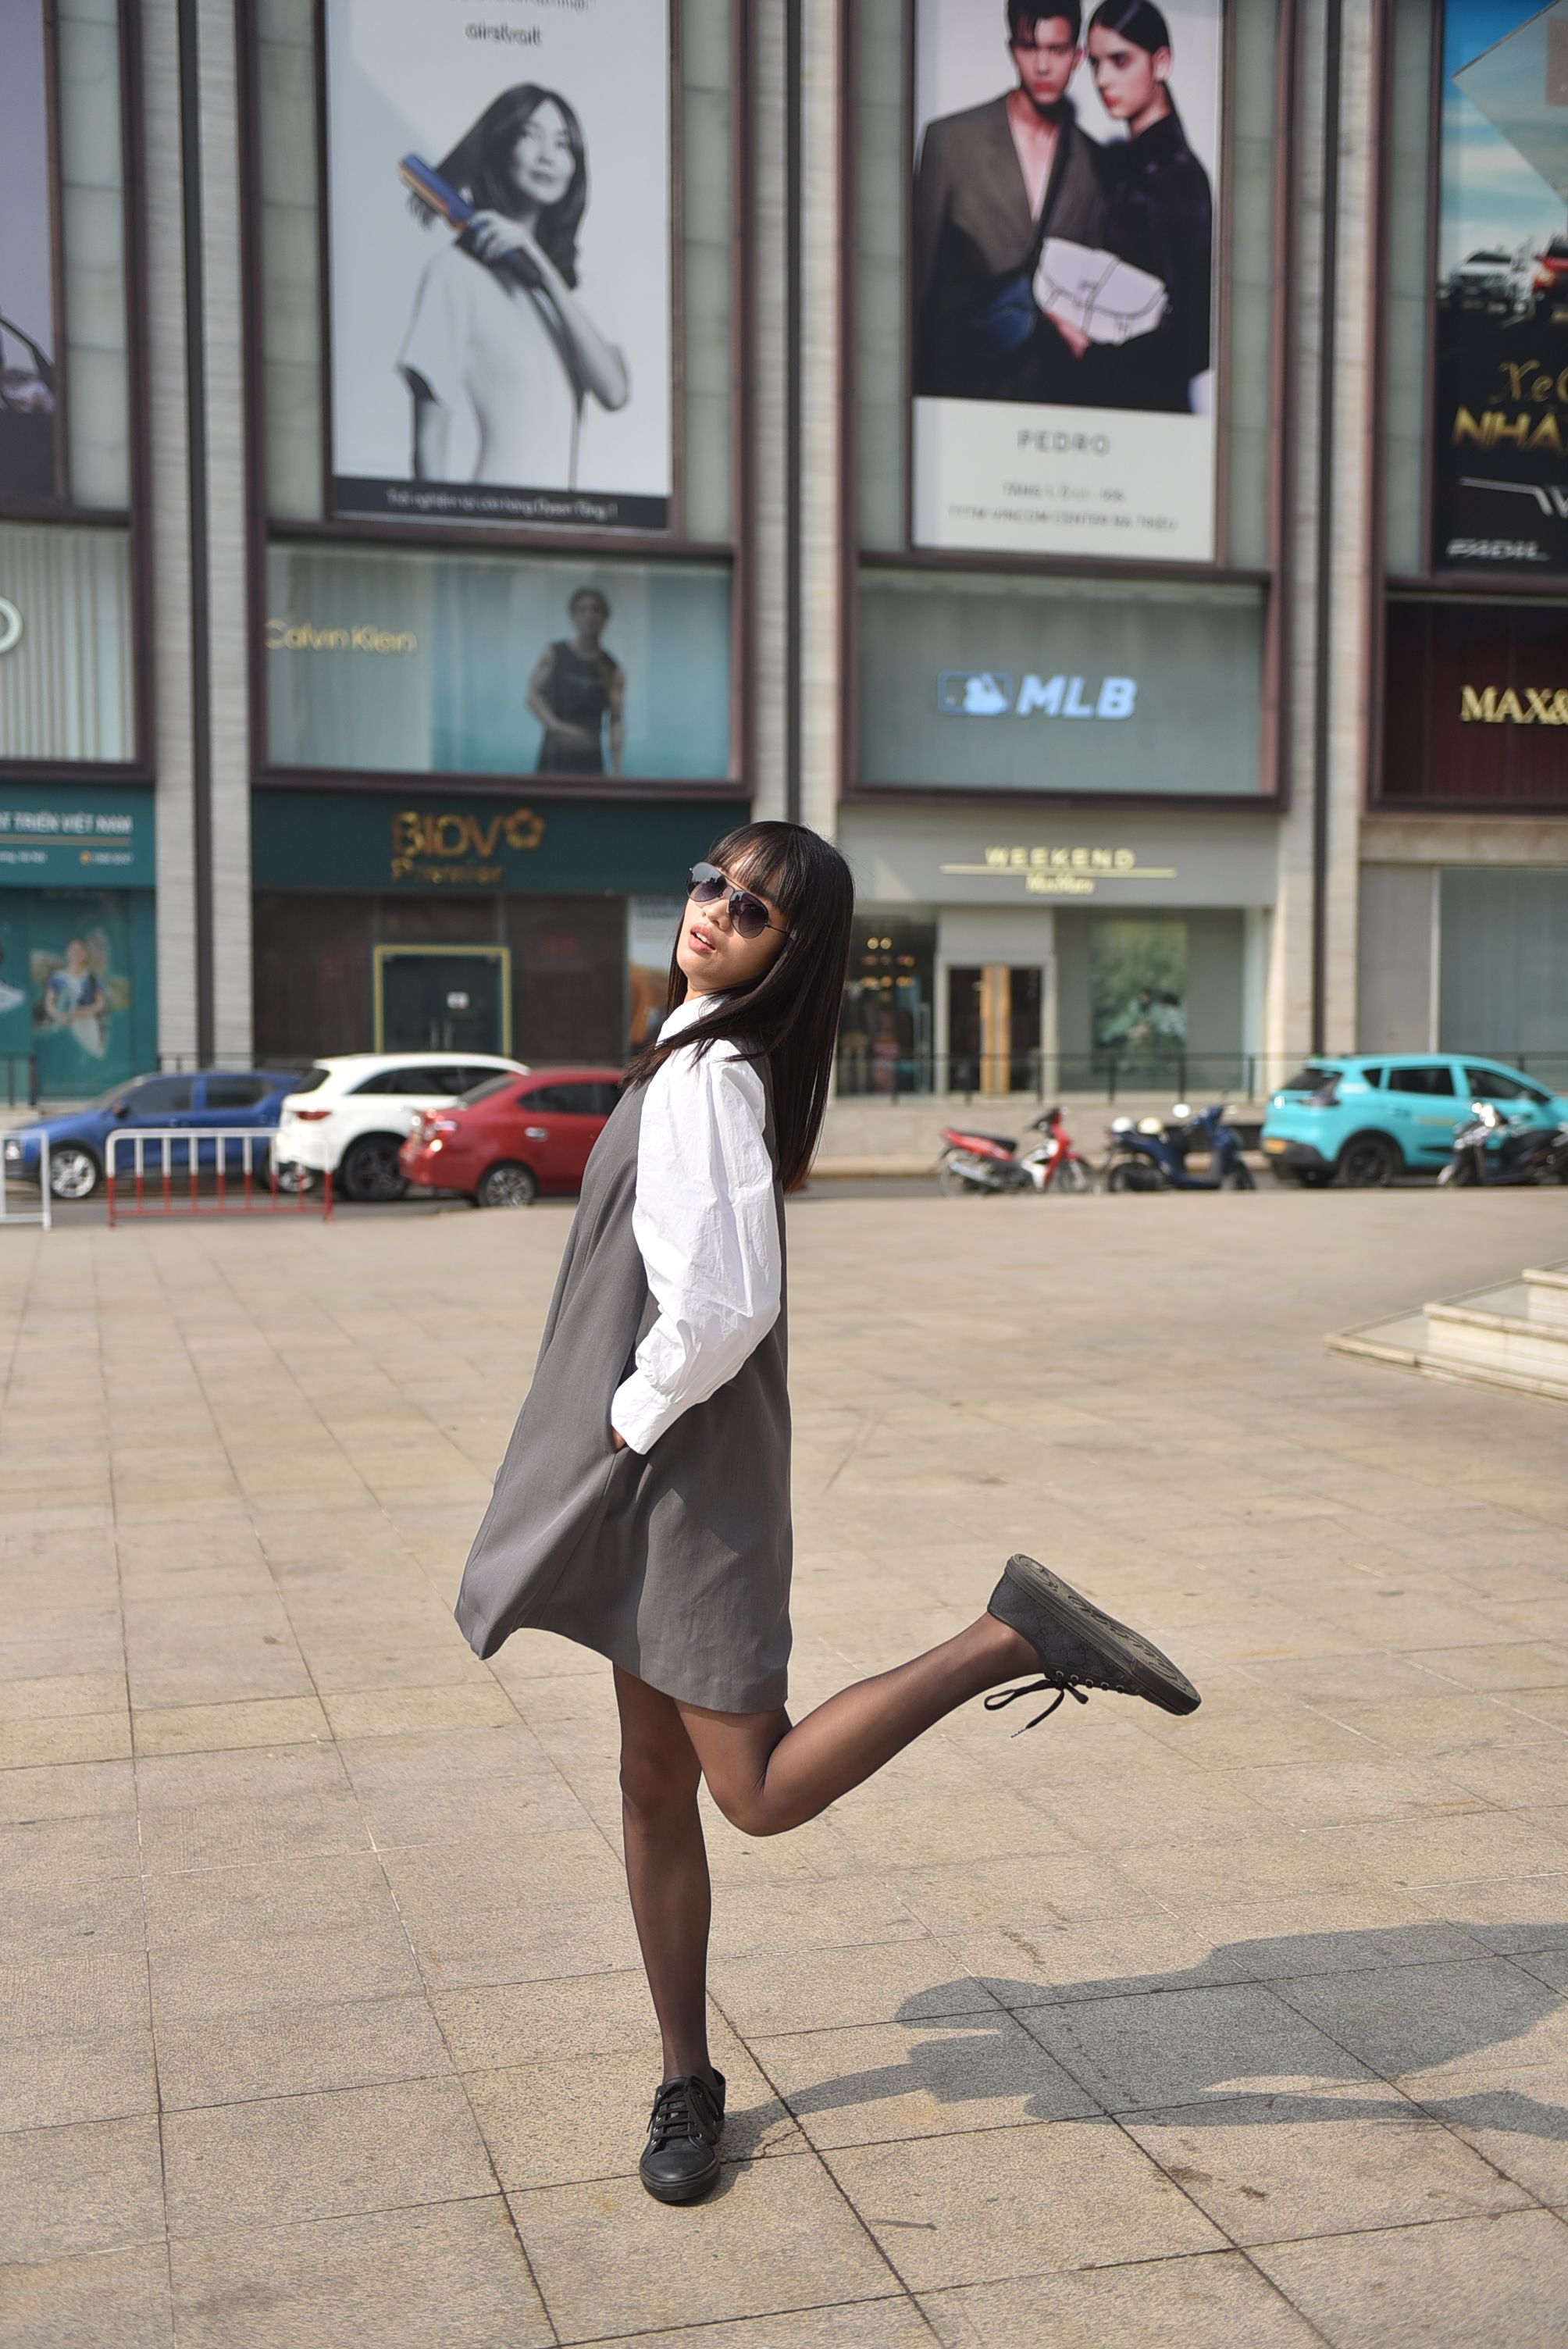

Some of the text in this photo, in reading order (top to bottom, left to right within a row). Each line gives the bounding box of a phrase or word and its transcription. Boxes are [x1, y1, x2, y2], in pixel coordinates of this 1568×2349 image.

[1017, 430, 1110, 457] PEDRO
[265, 618, 419, 655] Calvin Klein
[1016, 672, 1138, 720] MLB
[392, 811, 504, 857] BIDV
[985, 845, 1136, 868] WEEKEND
